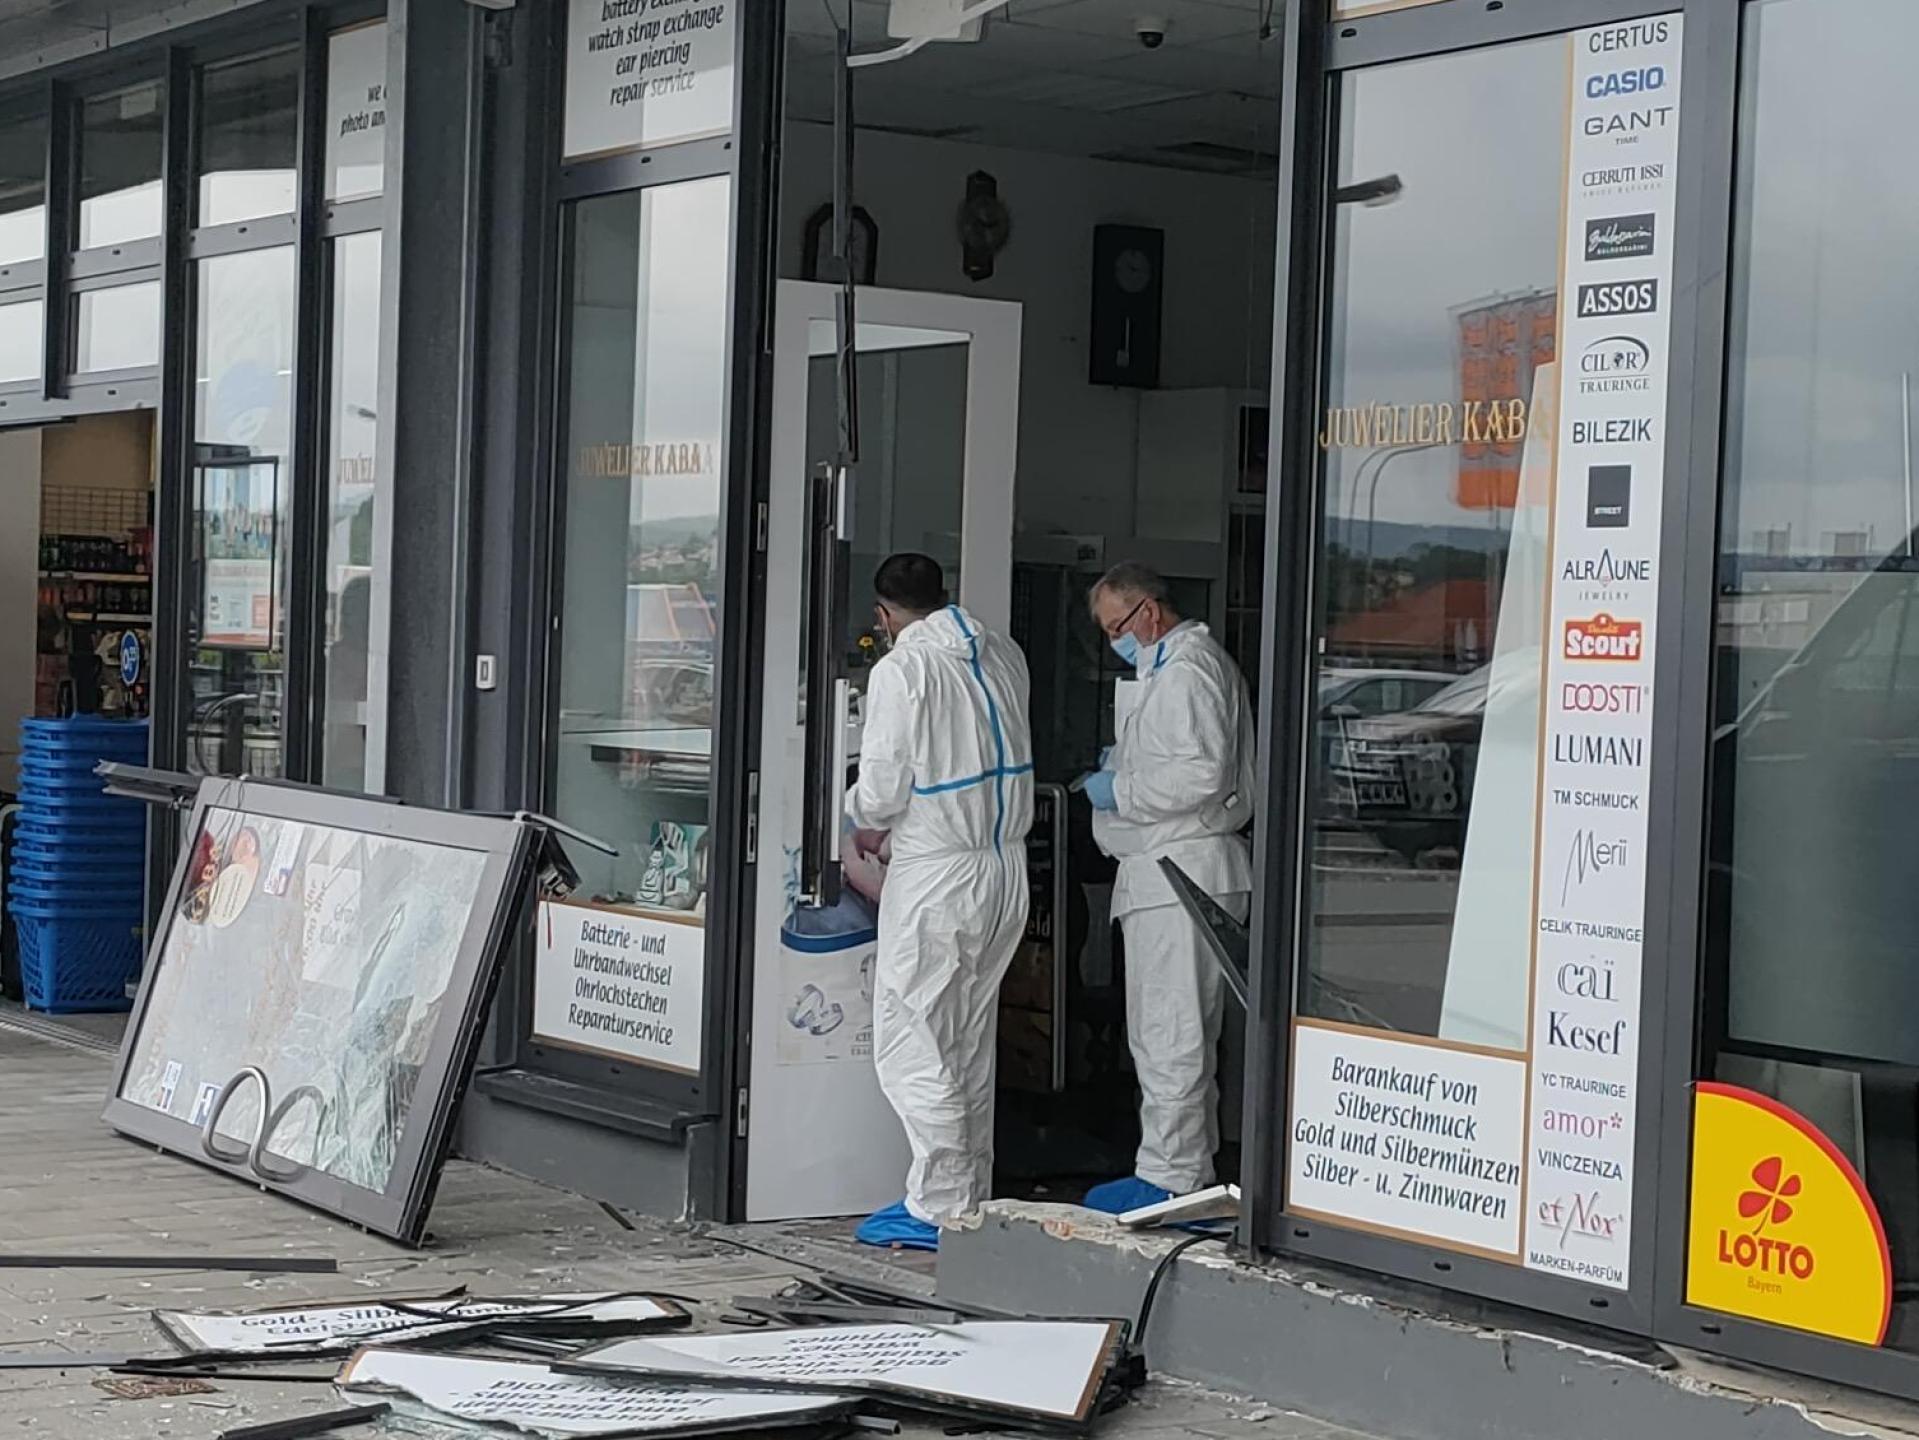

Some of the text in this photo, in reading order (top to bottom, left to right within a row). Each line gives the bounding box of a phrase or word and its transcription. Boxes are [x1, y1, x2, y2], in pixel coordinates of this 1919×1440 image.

[588, 5, 724, 52] watch strap exchange
[1589, 21, 1669, 52] CERTUS
[616, 40, 691, 75] ear piercing
[610, 68, 696, 106] repair service
[1586, 66, 1664, 99] CASIO
[341, 110, 386, 138] photo an
[1584, 107, 1673, 135] GANT
[1583, 167, 1636, 187] CERRUTI
[1582, 284, 1652, 313] ASSOS
[1580, 378, 1650, 393] TRAURINGE
[1462, 398, 1530, 442] KAB
[1573, 418, 1651, 443] BILEZIK
[1563, 549, 1650, 581] ALRAUNE
[1566, 628, 1640, 656] Scout
[1562, 683, 1641, 713] DOOSTI
[1555, 733, 1642, 767] LUMANI
[1554, 790, 1639, 810] TM SCHMUCK
[581, 920, 630, 948] Batterie
[642, 934, 666, 956] und
[1540, 918, 1642, 943] CELIK TRAURINGE
[574, 947, 672, 986] Uhrbandwechsel
[575, 976, 668, 1015] Ohrlochstechen
[569, 1003, 673, 1046] Reparaturservice
[1547, 1010, 1626, 1055] Kesef
[1332, 1056, 1478, 1106] Barankauf von
[1541, 1072, 1627, 1099] YC TRAURINGE
[1335, 1091, 1478, 1142] Silberschmuck
[1295, 1117, 1520, 1187] Gold und Silbermünzen
[1538, 1149, 1624, 1181] VINCZENZA
[1302, 1153, 1359, 1188] Silber
[1375, 1172, 1392, 1195] u.
[1398, 1172, 1507, 1219] Zinnwaren
[1529, 1252, 1623, 1283] MARKEN-PARFÜM
[1719, 1229, 1814, 1279] LOTTO
[1748, 1276, 1782, 1295] Bayern
